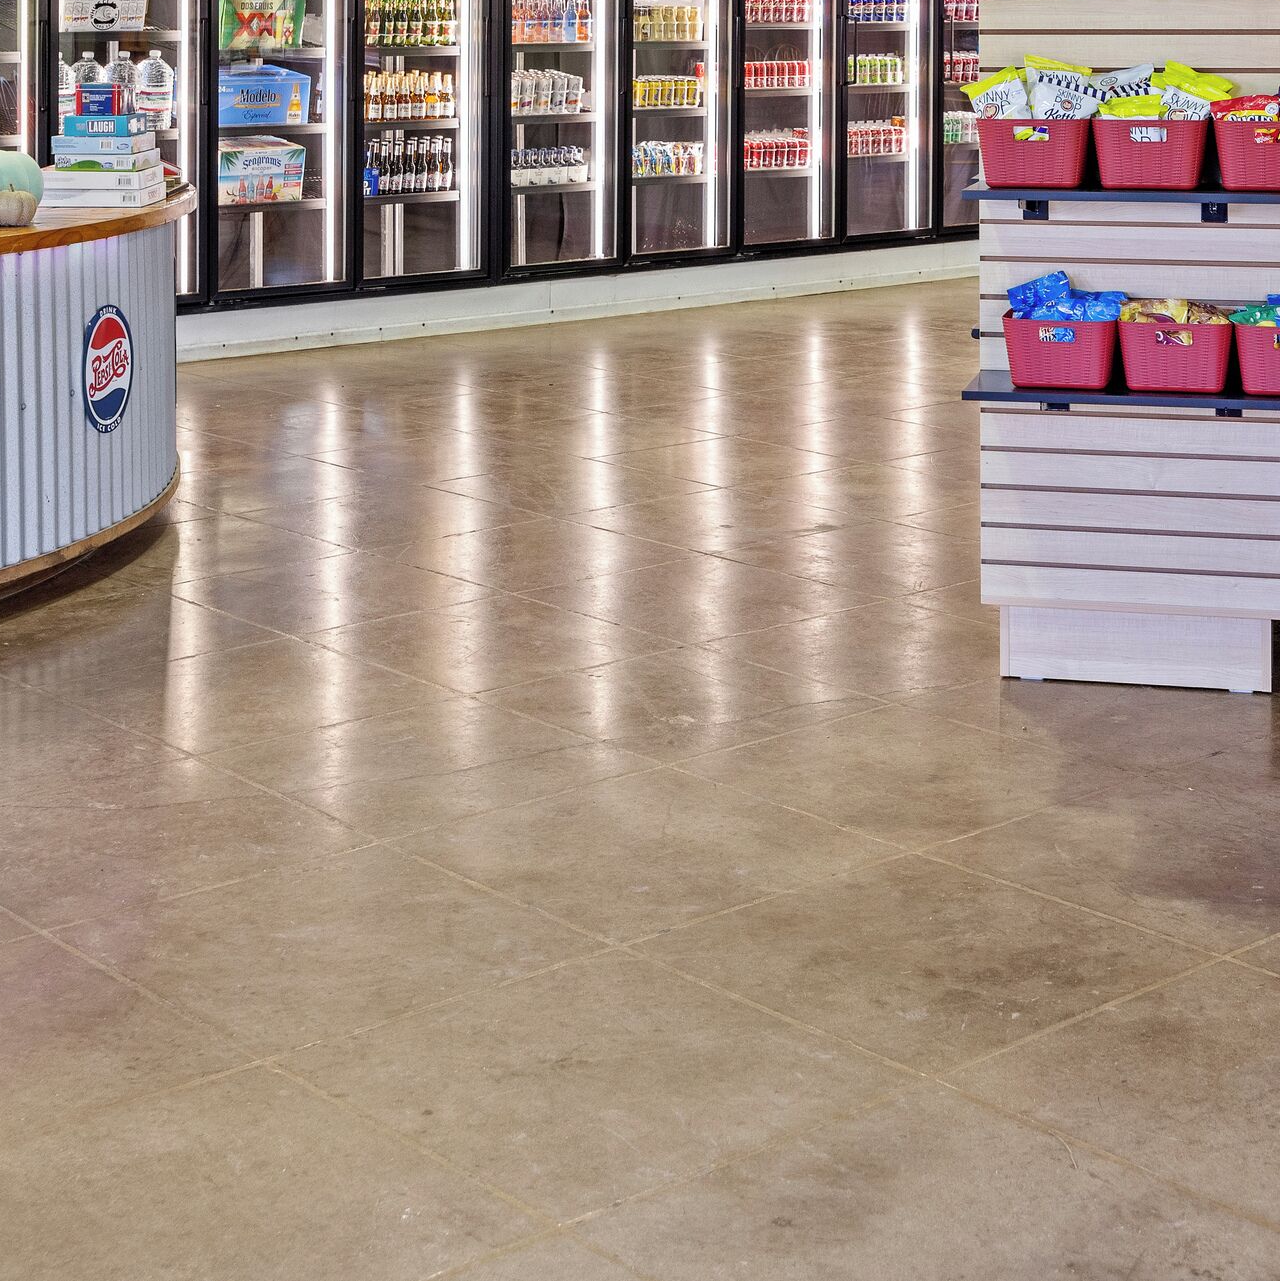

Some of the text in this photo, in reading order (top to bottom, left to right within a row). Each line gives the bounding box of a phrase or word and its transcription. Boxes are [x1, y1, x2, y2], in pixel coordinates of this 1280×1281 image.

[241, 2, 253, 10] DOS
[235, 12, 275, 37] XX
[240, 89, 276, 103] Modelo
[1058, 89, 1084, 104] SKINNY
[1171, 93, 1210, 112] SKINNY
[88, 121, 114, 133] LAUGH
[242, 155, 282, 170] Seagram's
[100, 306, 117, 317] DRINK
[97, 416, 121, 432] ICE COLD
